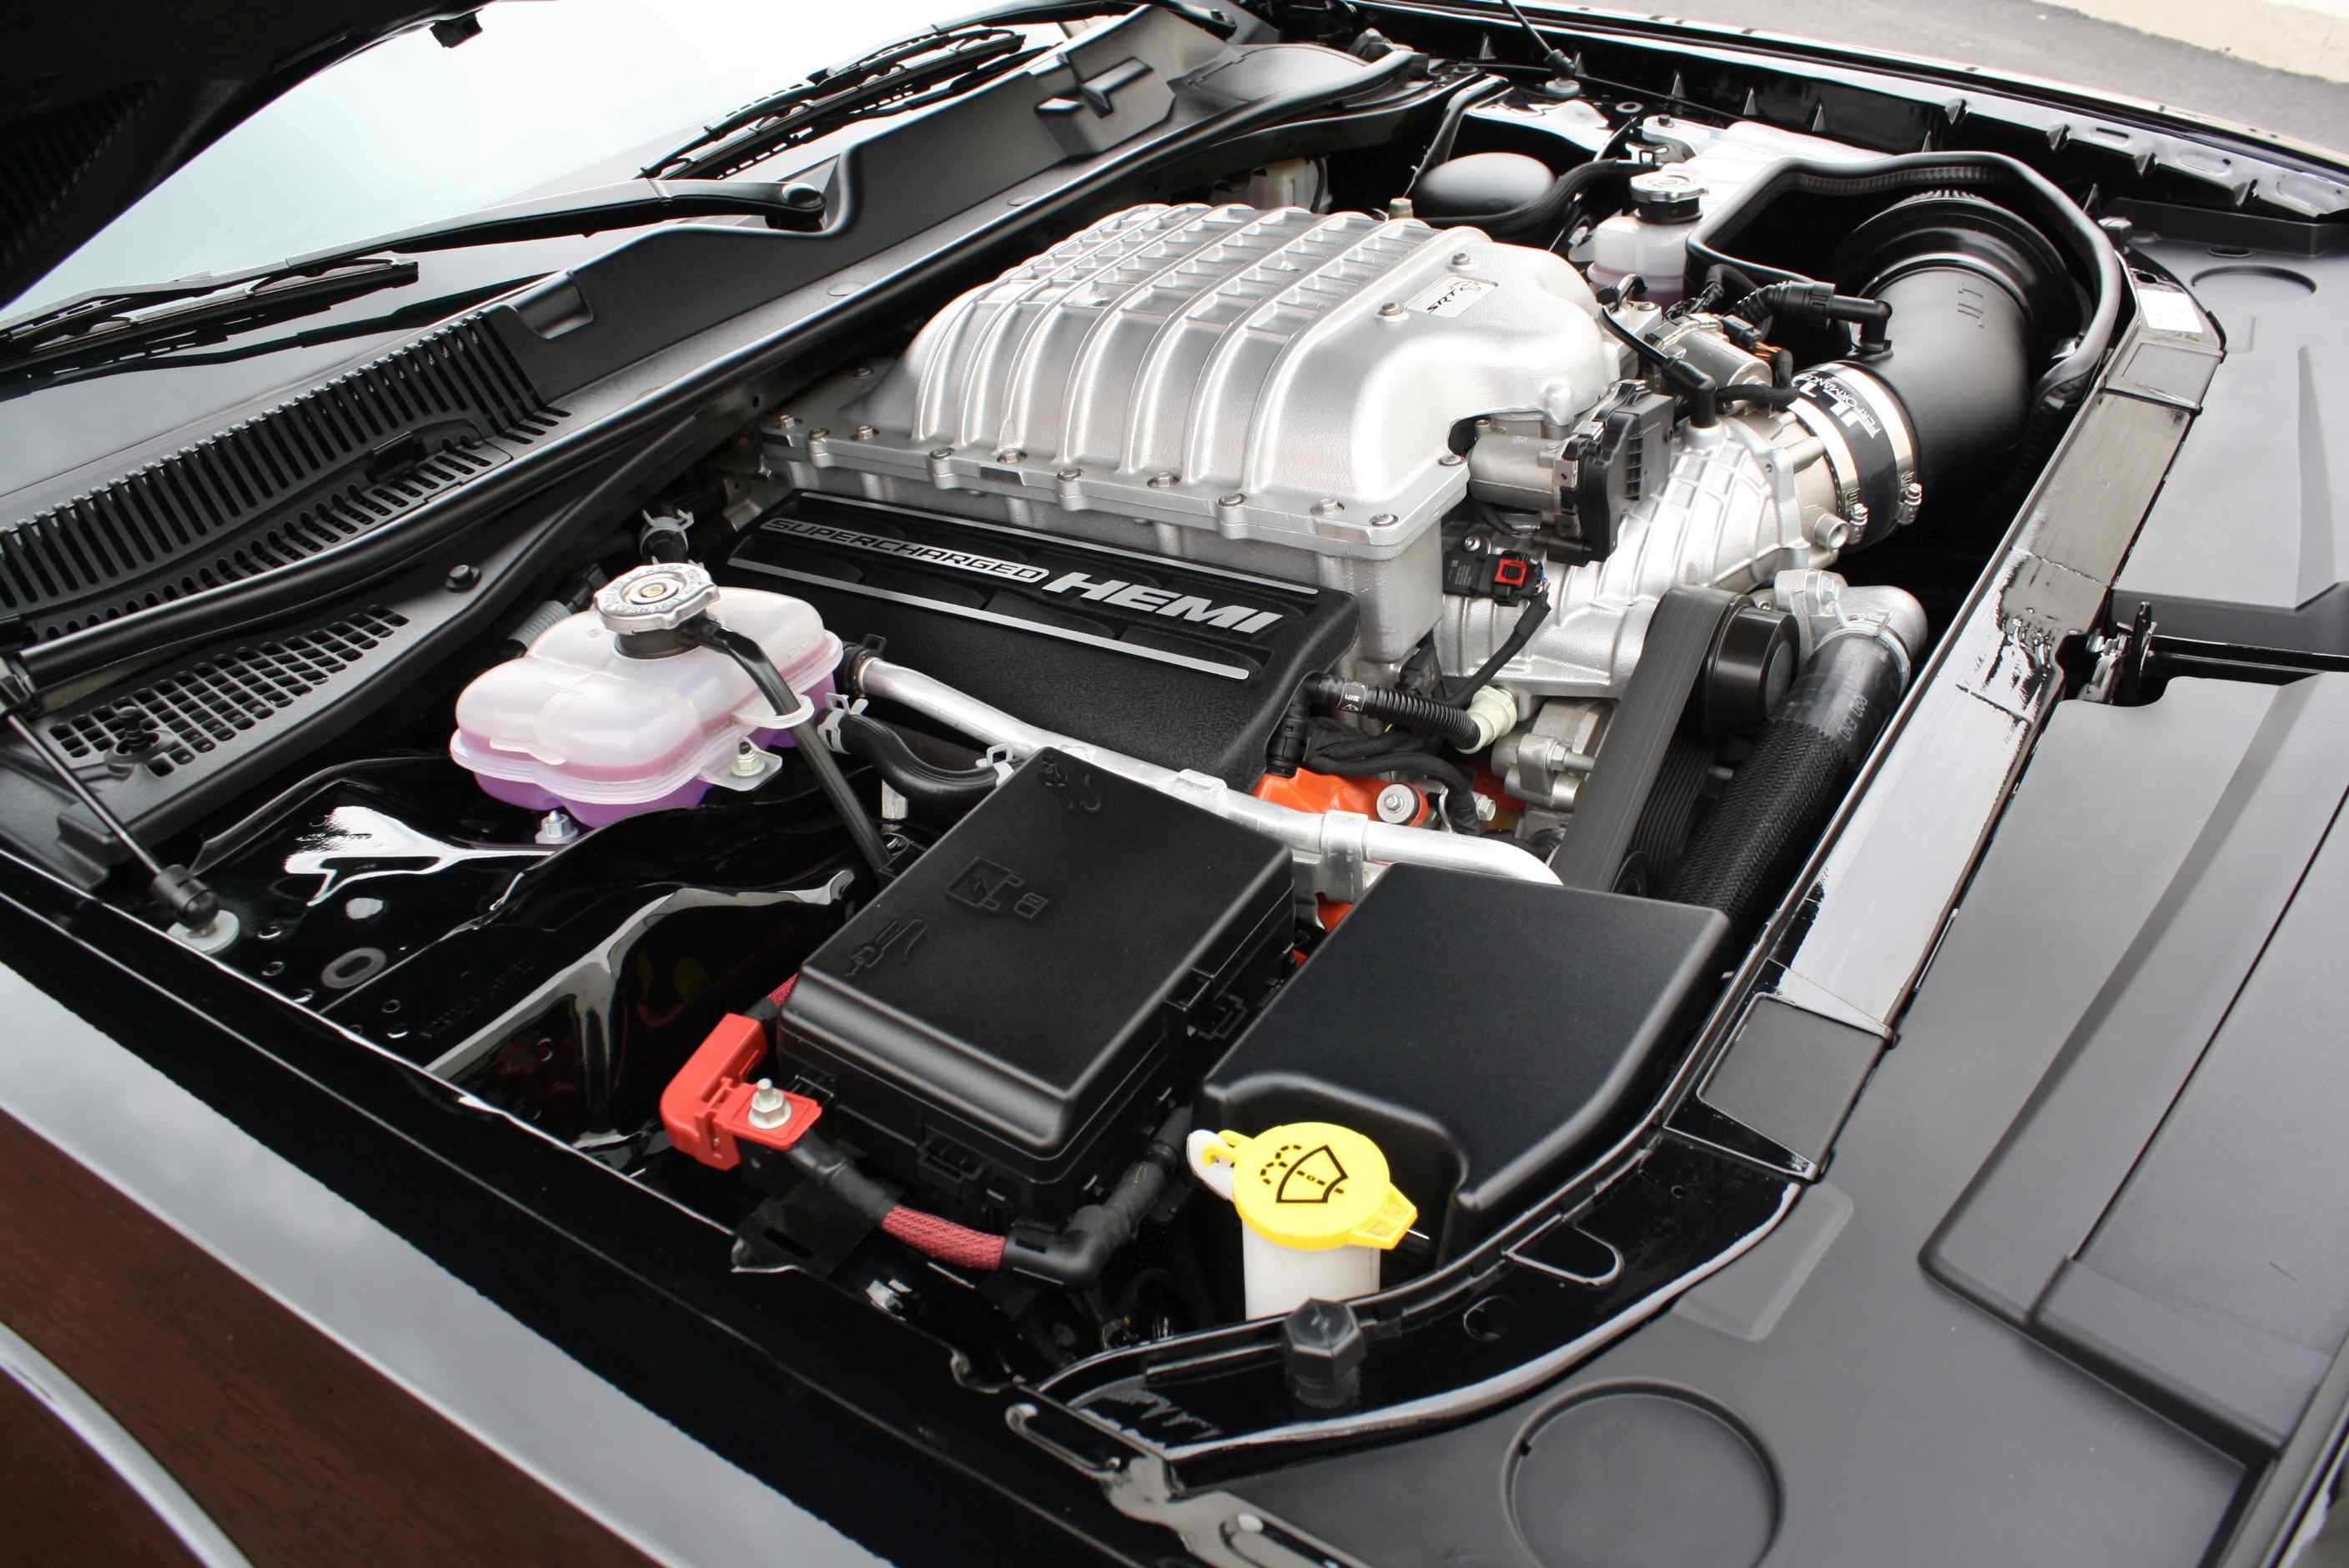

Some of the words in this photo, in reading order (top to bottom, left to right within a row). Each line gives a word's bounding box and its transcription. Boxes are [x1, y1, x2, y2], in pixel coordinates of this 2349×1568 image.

[1426, 289, 1456, 314] SRT
[1799, 381, 1875, 439] JLT
[764, 517, 1044, 580] SUPERCHARGED
[1043, 572, 1283, 634] HEMI
